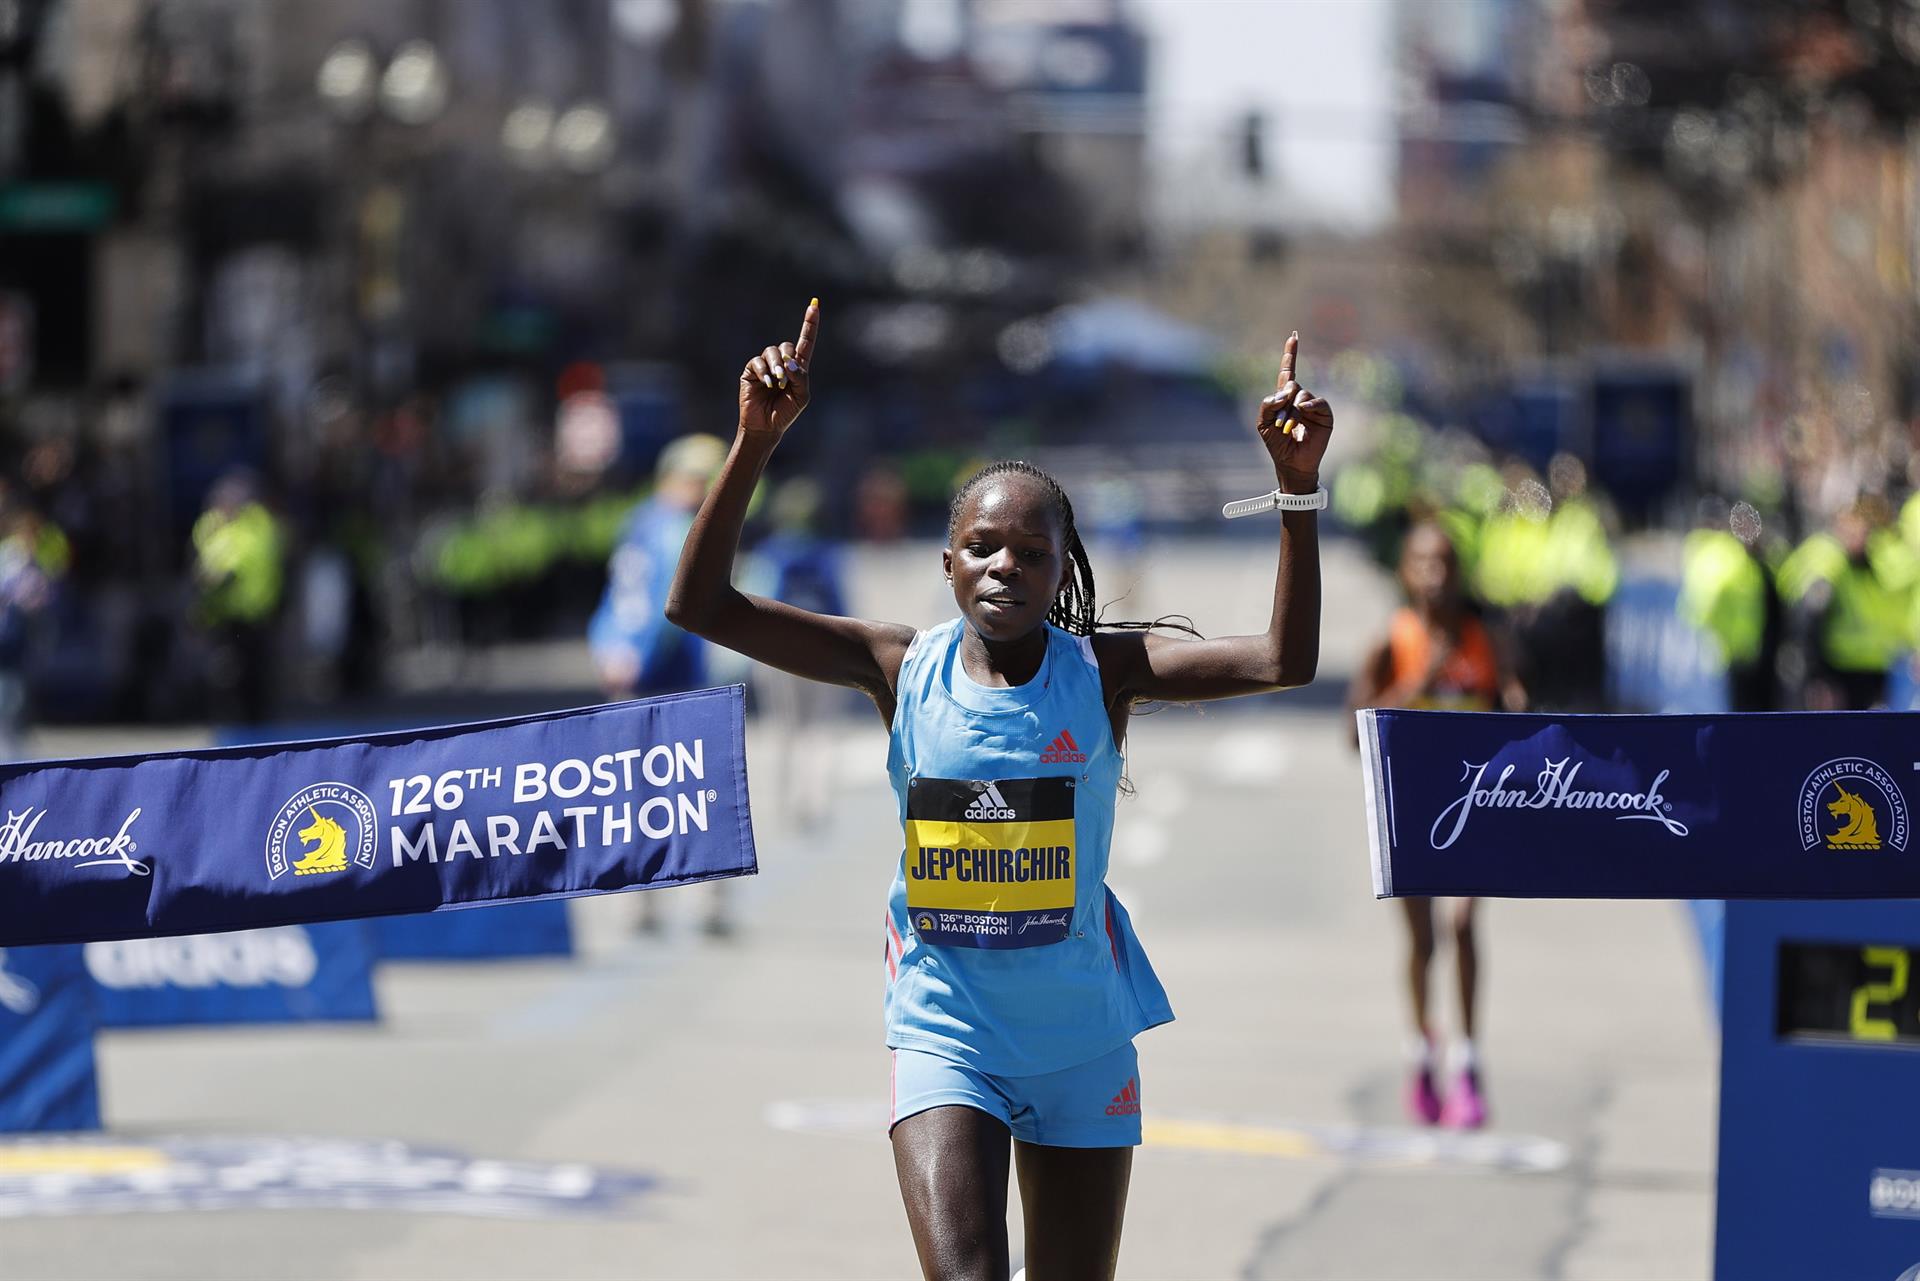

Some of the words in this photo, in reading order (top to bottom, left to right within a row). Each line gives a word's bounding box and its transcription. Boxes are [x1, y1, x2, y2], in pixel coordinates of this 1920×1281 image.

[388, 766, 502, 817] 126TH
[514, 738, 705, 804] BOSTON
[1040, 751, 1087, 764] adidas
[271, 819, 288, 873] BOSTON
[286, 788, 340, 819] ATHLETIC
[340, 791, 373, 863] ASSOCIATION
[964, 806, 1017, 820] adidas
[1430, 760, 1527, 850] John
[1803, 789, 1815, 843] BOSTON
[1811, 763, 1864, 791] ATHLETIC
[1865, 767, 1905, 845] ASSOCIATION
[911, 845, 1071, 883] JEPCHIRCHIR
[939, 913, 963, 923] 126TH
[964, 915, 1008, 925] BOSTON
[1851, 946, 1909, 1041] 2
